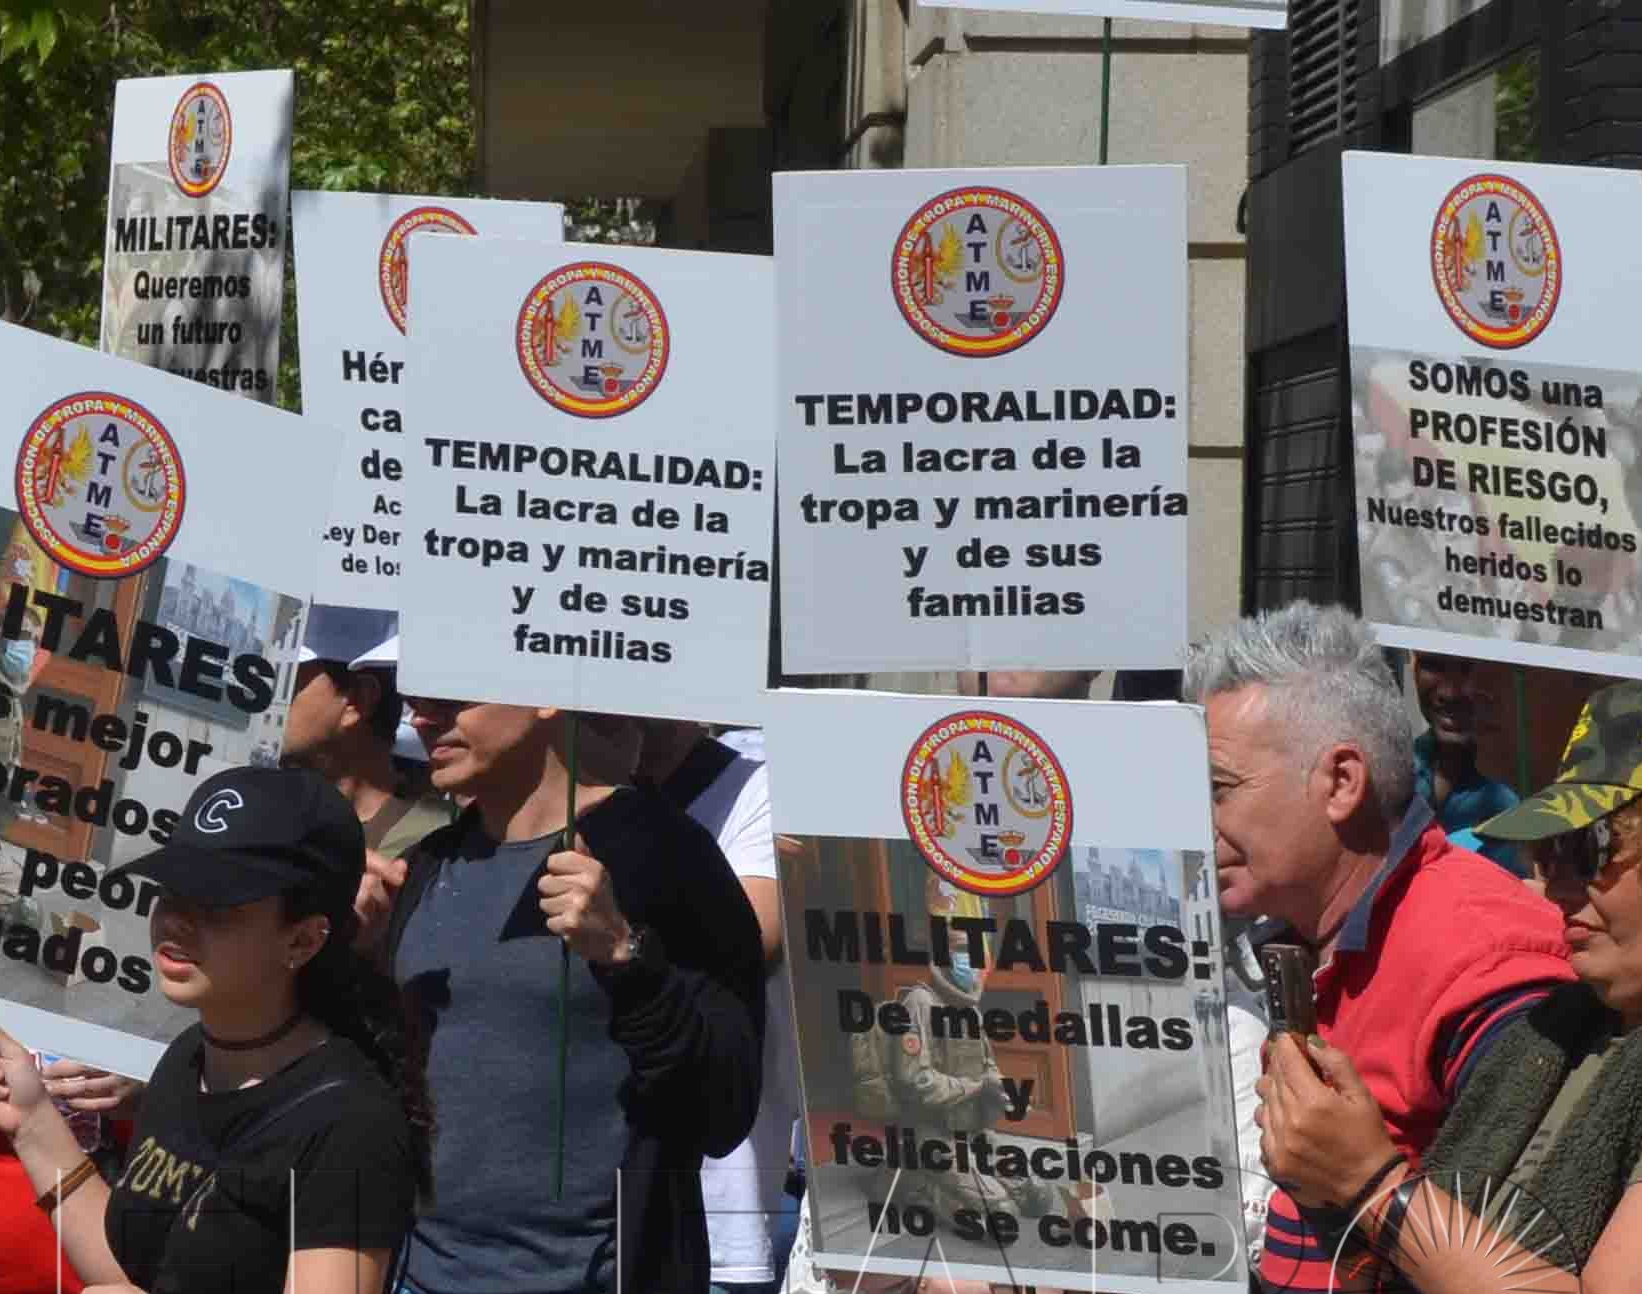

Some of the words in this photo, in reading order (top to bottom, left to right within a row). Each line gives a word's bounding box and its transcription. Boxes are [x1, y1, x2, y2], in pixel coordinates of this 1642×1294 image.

[114, 212, 277, 255] MILITARES:
[1486, 200, 1505, 313] ATME
[133, 269, 252, 302] Queremos
[965, 213, 990, 322] ATME
[137, 321, 168, 346] un
[172, 316, 243, 347] futuro
[580, 285, 604, 386] ATME
[795, 388, 1177, 426] TEMPORALIDAD:
[1408, 360, 1531, 403] SOMOS
[1541, 379, 1604, 409] una
[833, 443, 886, 476] La
[902, 439, 1017, 474] lacra
[1032, 438, 1086, 471] de
[1102, 437, 1141, 470] la
[1408, 408, 1608, 459] PROFESIÓN
[84, 422, 121, 539] ATME
[425, 437, 763, 492] TEMPORALIDAD:
[1412, 456, 1457, 493] DE
[1468, 463, 1610, 514] RIESGO,
[455, 485, 502, 516] La
[516, 488, 617, 529] lacra
[631, 496, 681, 531] de
[694, 502, 729, 534] la
[799, 489, 919, 530] tropa
[933, 493, 959, 529] y
[973, 484, 1189, 520] marinería
[1366, 497, 1490, 540] Nuestros
[1497, 512, 1638, 556] fallecidos
[341, 552, 369, 574] de
[424, 527, 530, 571] tropa
[542, 544, 564, 573] y
[577, 543, 769, 583] marinería
[902, 543, 928, 577] y
[956, 538, 1010, 570] de
[1025, 538, 1102, 568] sus
[1444, 546, 1548, 584] heridos
[1557, 558, 1583, 588] lo
[512, 583, 535, 615] y
[558, 581, 608, 616] de
[620, 588, 690, 620] sus
[906, 585, 1086, 619] familias
[1437, 586, 1605, 632] demuestran
[513, 623, 673, 664] familias
[41, 690, 214, 778] mejor
[194, 787, 244, 833] C
[972, 739, 1000, 858] ATME
[804, 908, 1212, 982] MILITARES:
[837, 989, 911, 1034] De
[931, 1000, 1195, 1053] medallas
[1002, 1077, 1035, 1122] y
[829, 1122, 1225, 1191] felicitaciones
[868, 1199, 936, 1237] no
[959, 1205, 1021, 1245] se
[1038, 1211, 1218, 1259] come.
